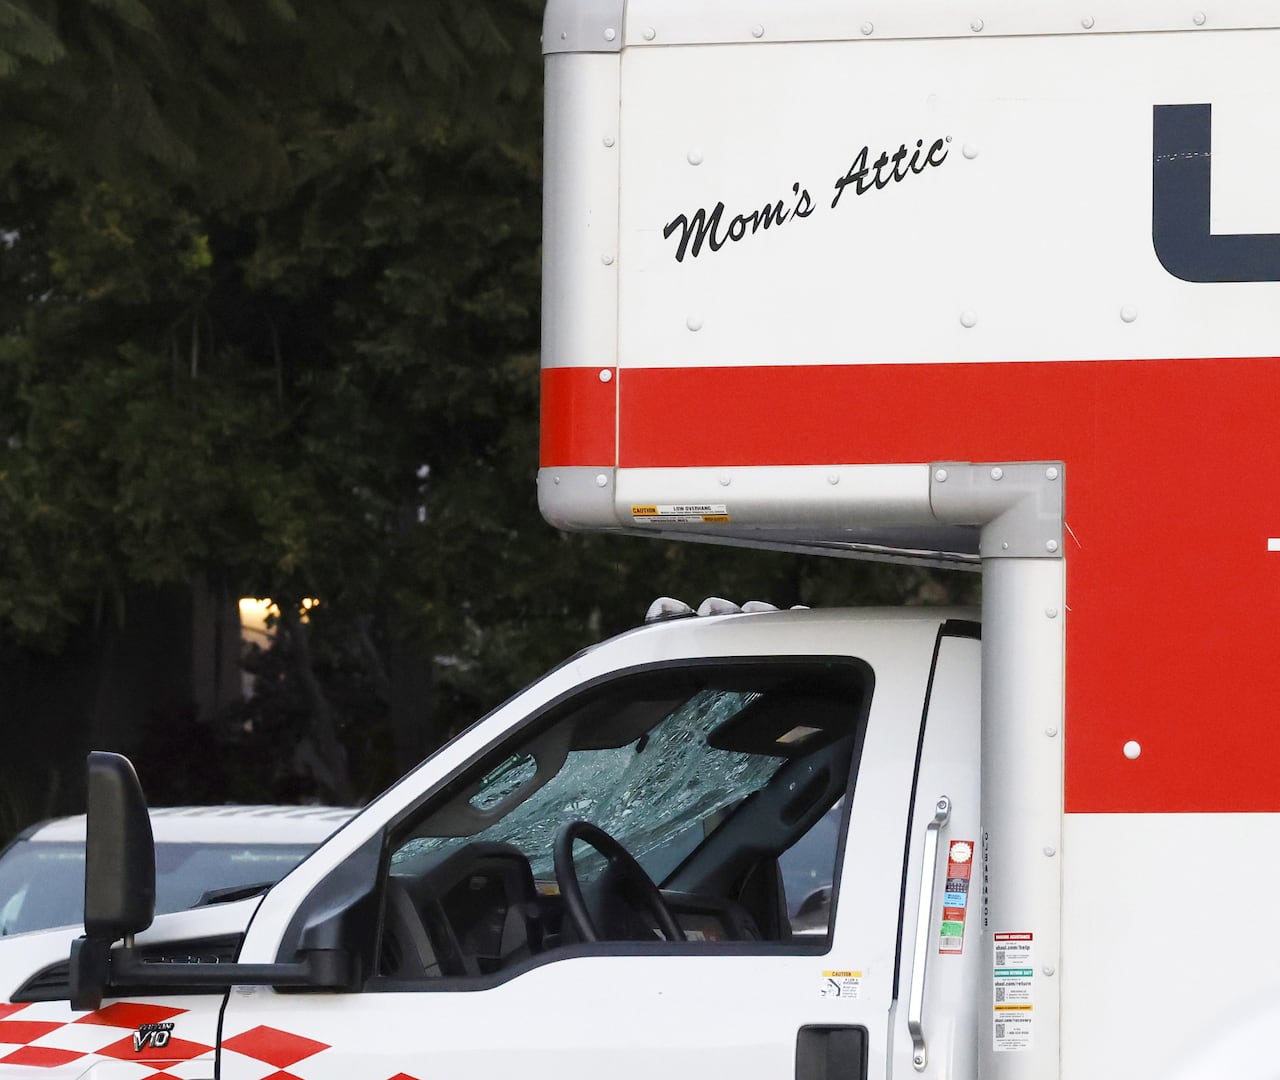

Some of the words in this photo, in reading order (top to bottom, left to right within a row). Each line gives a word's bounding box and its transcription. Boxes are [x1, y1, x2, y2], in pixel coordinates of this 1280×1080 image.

[663, 182, 816, 263] Mom's
[831, 138, 949, 209] Attic
[133, 1031, 170, 1051] V10
